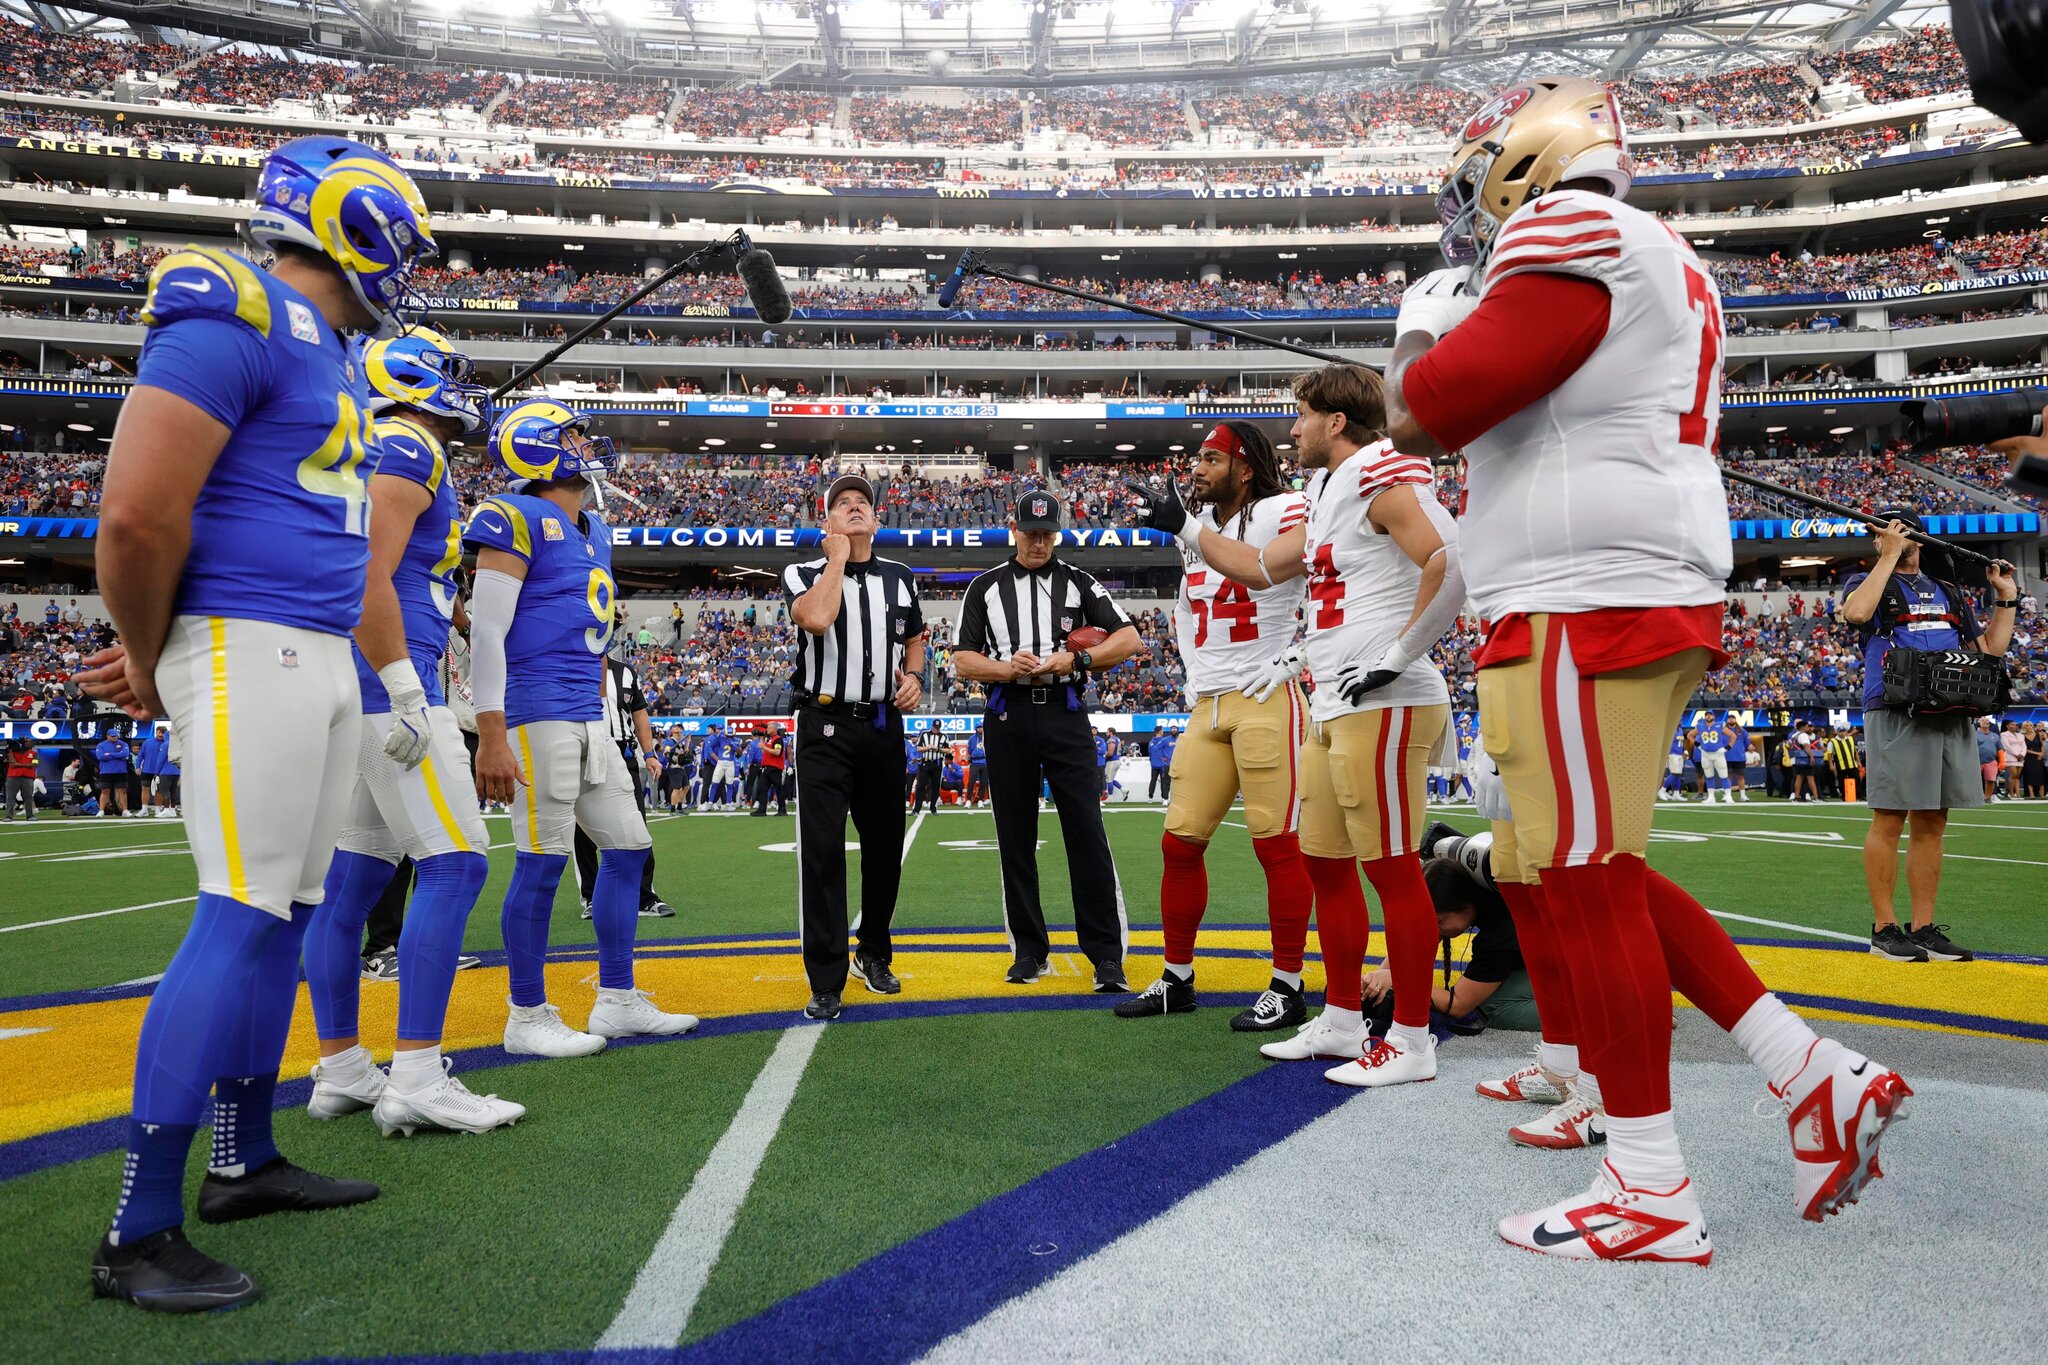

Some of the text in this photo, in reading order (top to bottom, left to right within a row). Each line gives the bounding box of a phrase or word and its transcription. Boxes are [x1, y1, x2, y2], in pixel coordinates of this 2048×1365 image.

[17, 138, 261, 168] ANGELES RAMS
[1192, 187, 1312, 199] WELCOME
[1325, 186, 1355, 197] TO
[1368, 185, 1414, 196] THE
[1845, 288, 1881, 301] WHAT
[1882, 284, 1920, 299] MAKES
[1943, 275, 2005, 293] DIFFERENT
[2007, 273, 2020, 285] IS
[408, 297, 443, 308] BRINGS
[445, 297, 460, 308] US
[461, 299, 518, 310] TOGETHER
[708, 403, 750, 414] RAMS
[829, 404, 839, 415] 0
[850, 405, 859, 415] 0
[942, 405, 968, 416] 0:48
[977, 405, 996, 416] :25
[1125, 405, 1165, 416] RAMS
[612, 528, 795, 547] ELCOME
[900, 529, 982, 547] THE
[585, 567, 615, 655] 9
[1186, 571, 1259, 649] 54
[1156, 718, 1190, 728] RAM
[1461, 735, 1474, 749] 18
[1701, 731, 1719, 744] 68
[722, 745, 732, 758] 2
[1810, 1108, 1823, 1148] ALPHA
[1608, 1224, 1648, 1246] ALPHA
